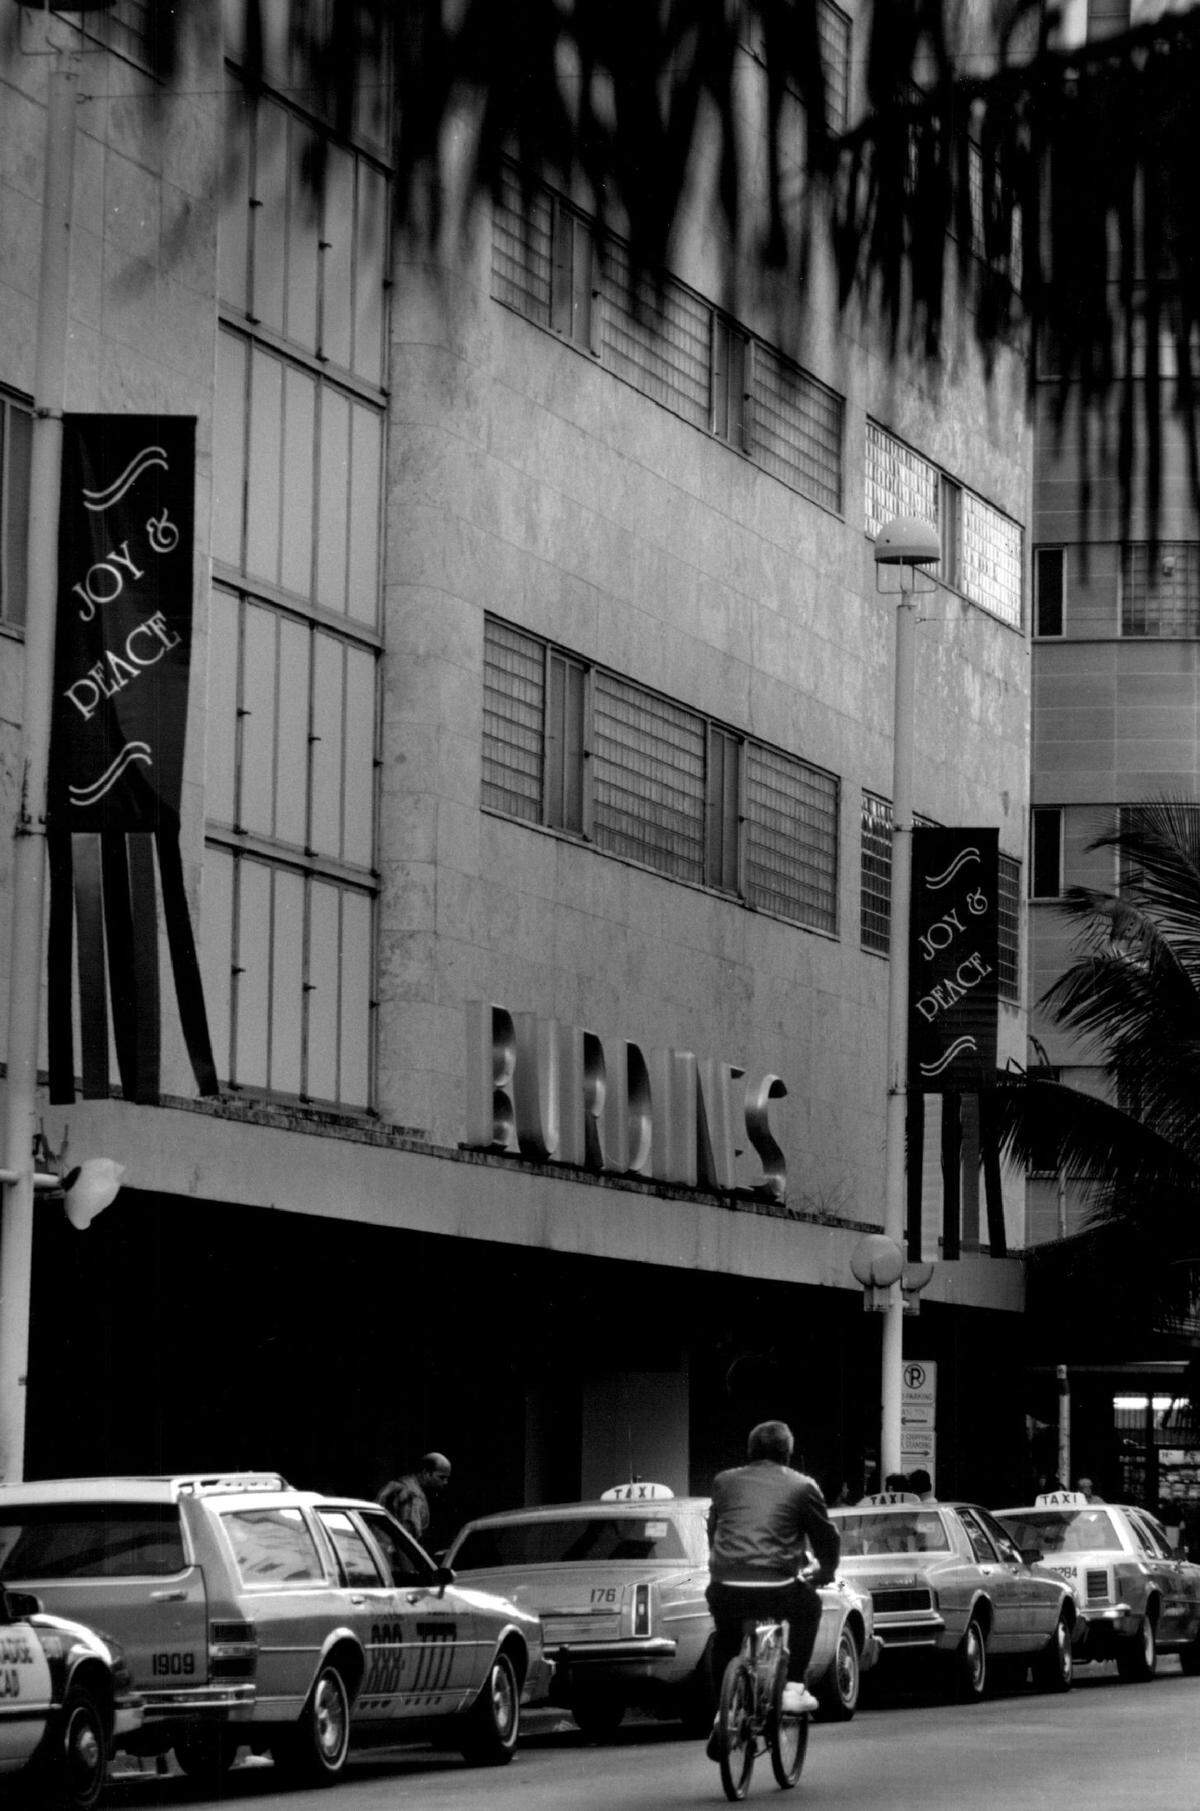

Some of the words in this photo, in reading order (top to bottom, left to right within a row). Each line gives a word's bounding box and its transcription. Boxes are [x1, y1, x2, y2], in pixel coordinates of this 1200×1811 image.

[72, 541, 144, 622] JOY
[146, 507, 179, 553] &
[63, 610, 182, 721] PEACE
[918, 908, 967, 961] JOY
[967, 887, 988, 915] &
[915, 951, 992, 1023] PEACE
[614, 1486, 655, 1499] TAXI
[871, 1493, 904, 1505] TAXI
[1040, 1493, 1077, 1505] TAXI
[590, 1588, 616, 1603] 176
[152, 1652, 195, 1676] 1909
